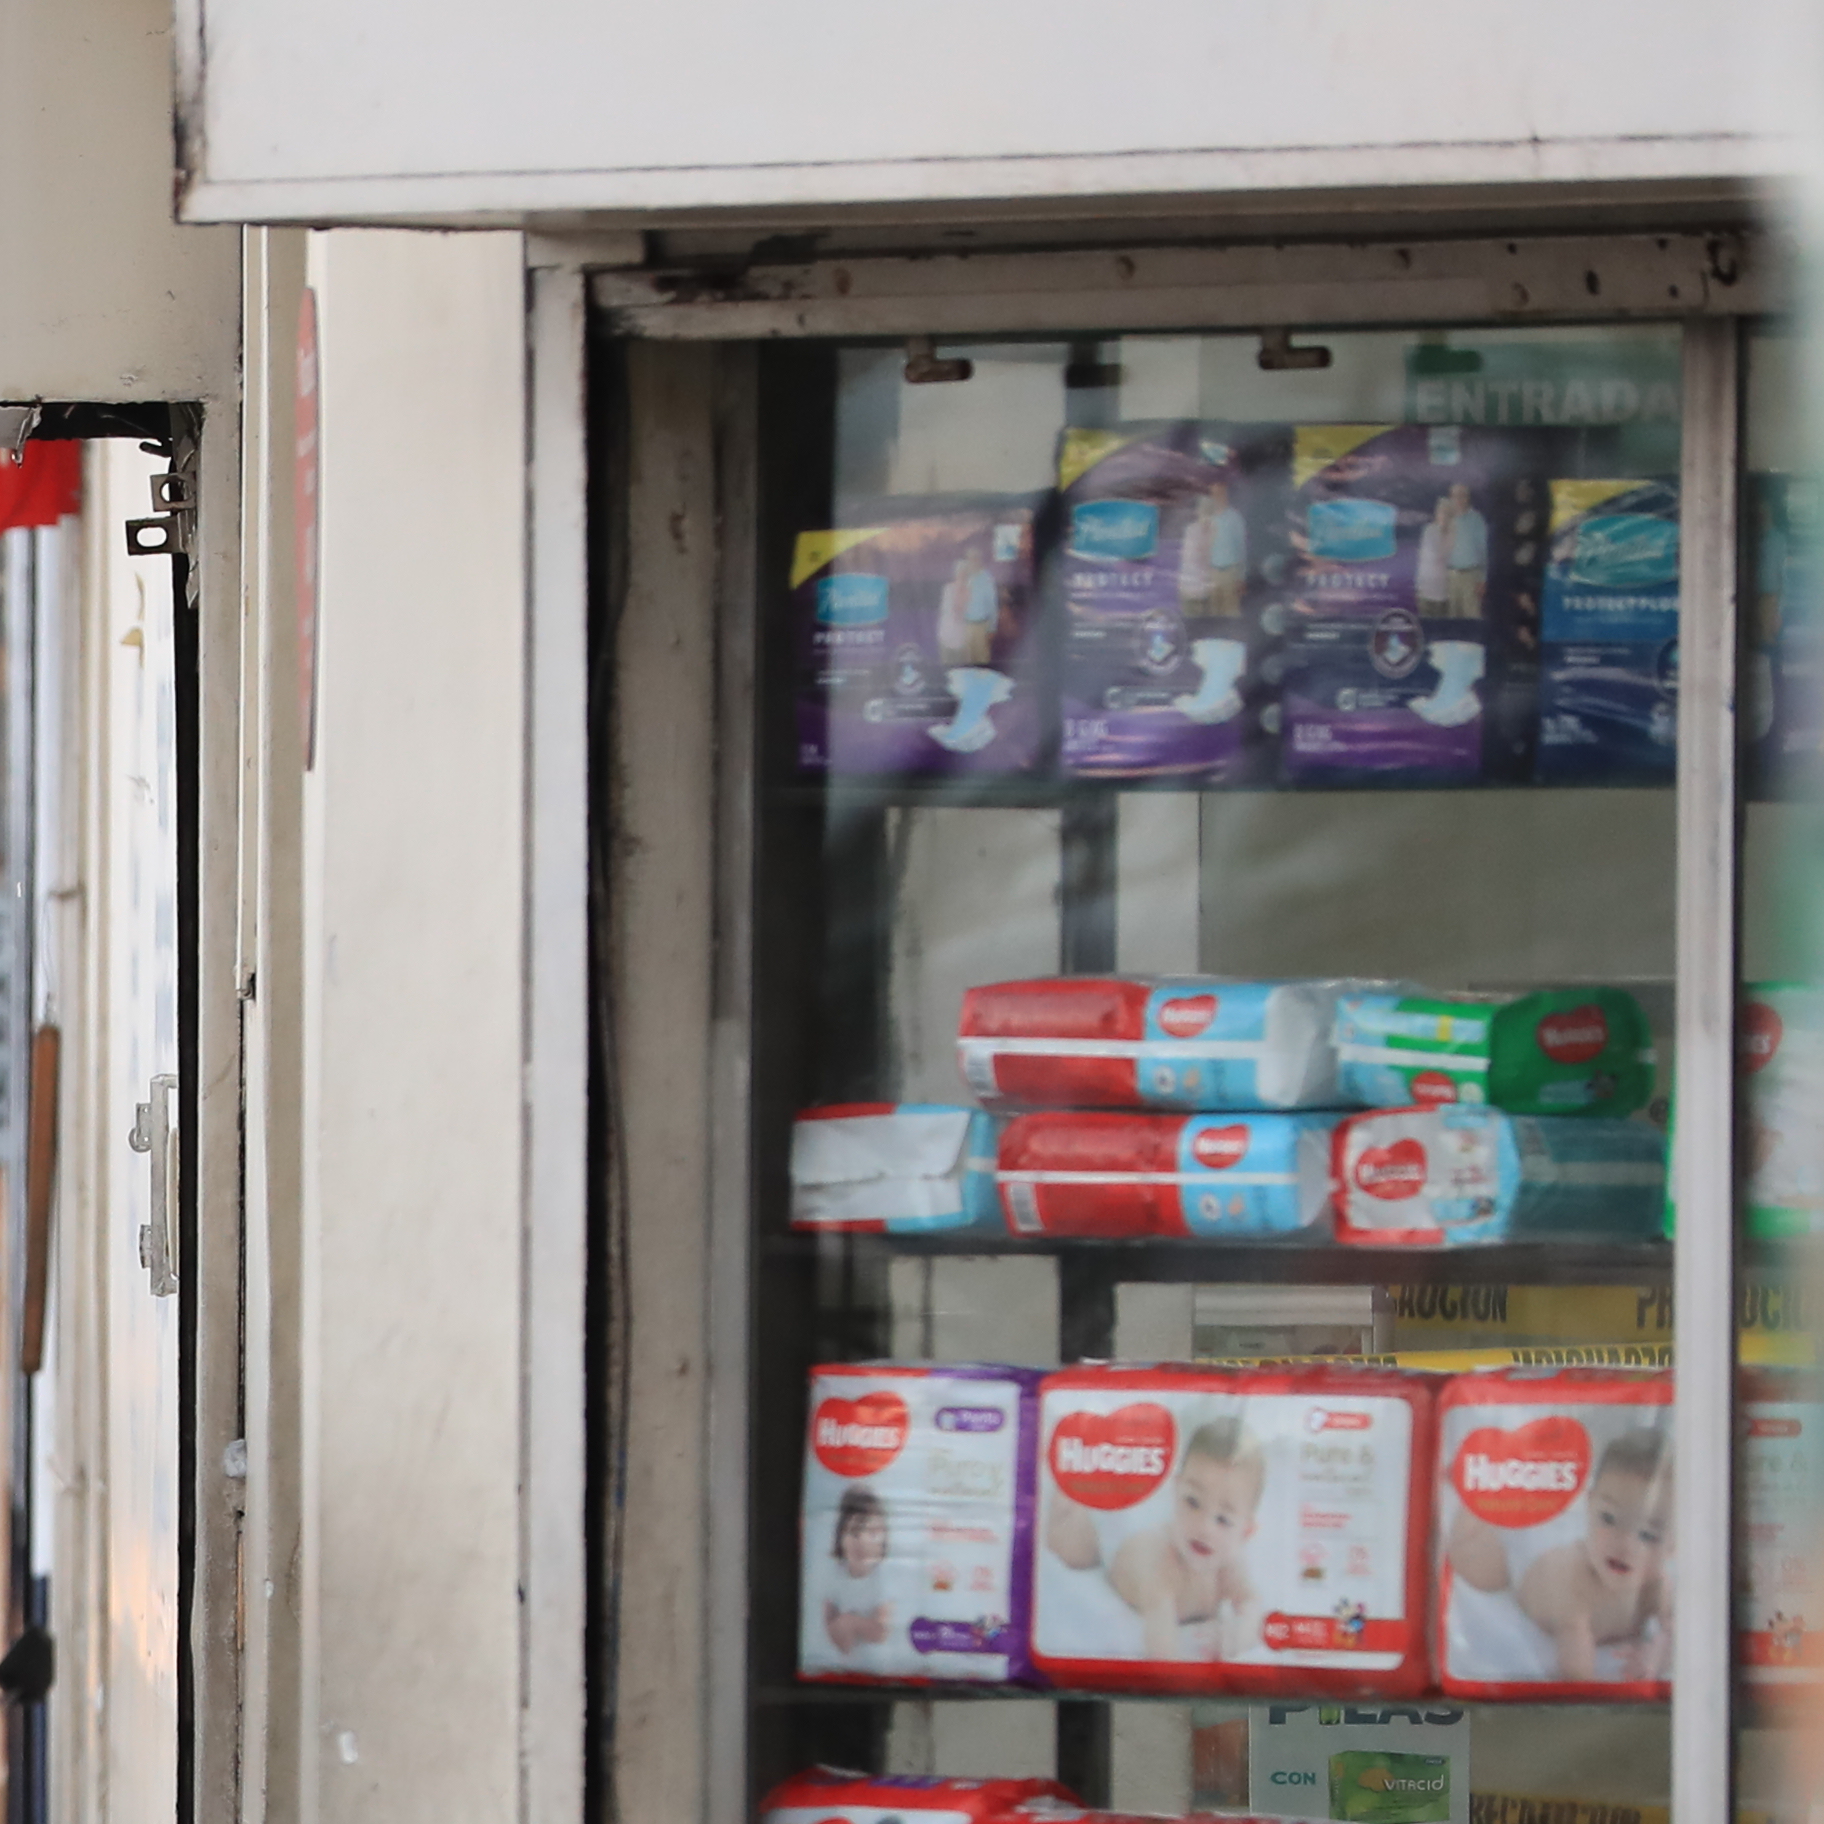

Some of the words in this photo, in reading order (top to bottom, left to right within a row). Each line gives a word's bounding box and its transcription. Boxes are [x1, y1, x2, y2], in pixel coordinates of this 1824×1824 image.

[816, 1417, 901, 1450] HUGGIES
[1058, 1436, 1166, 1476] HUGGIES
[1464, 1453, 1578, 1493] HUGGIES
[1270, 1771, 1317, 1786] CON
